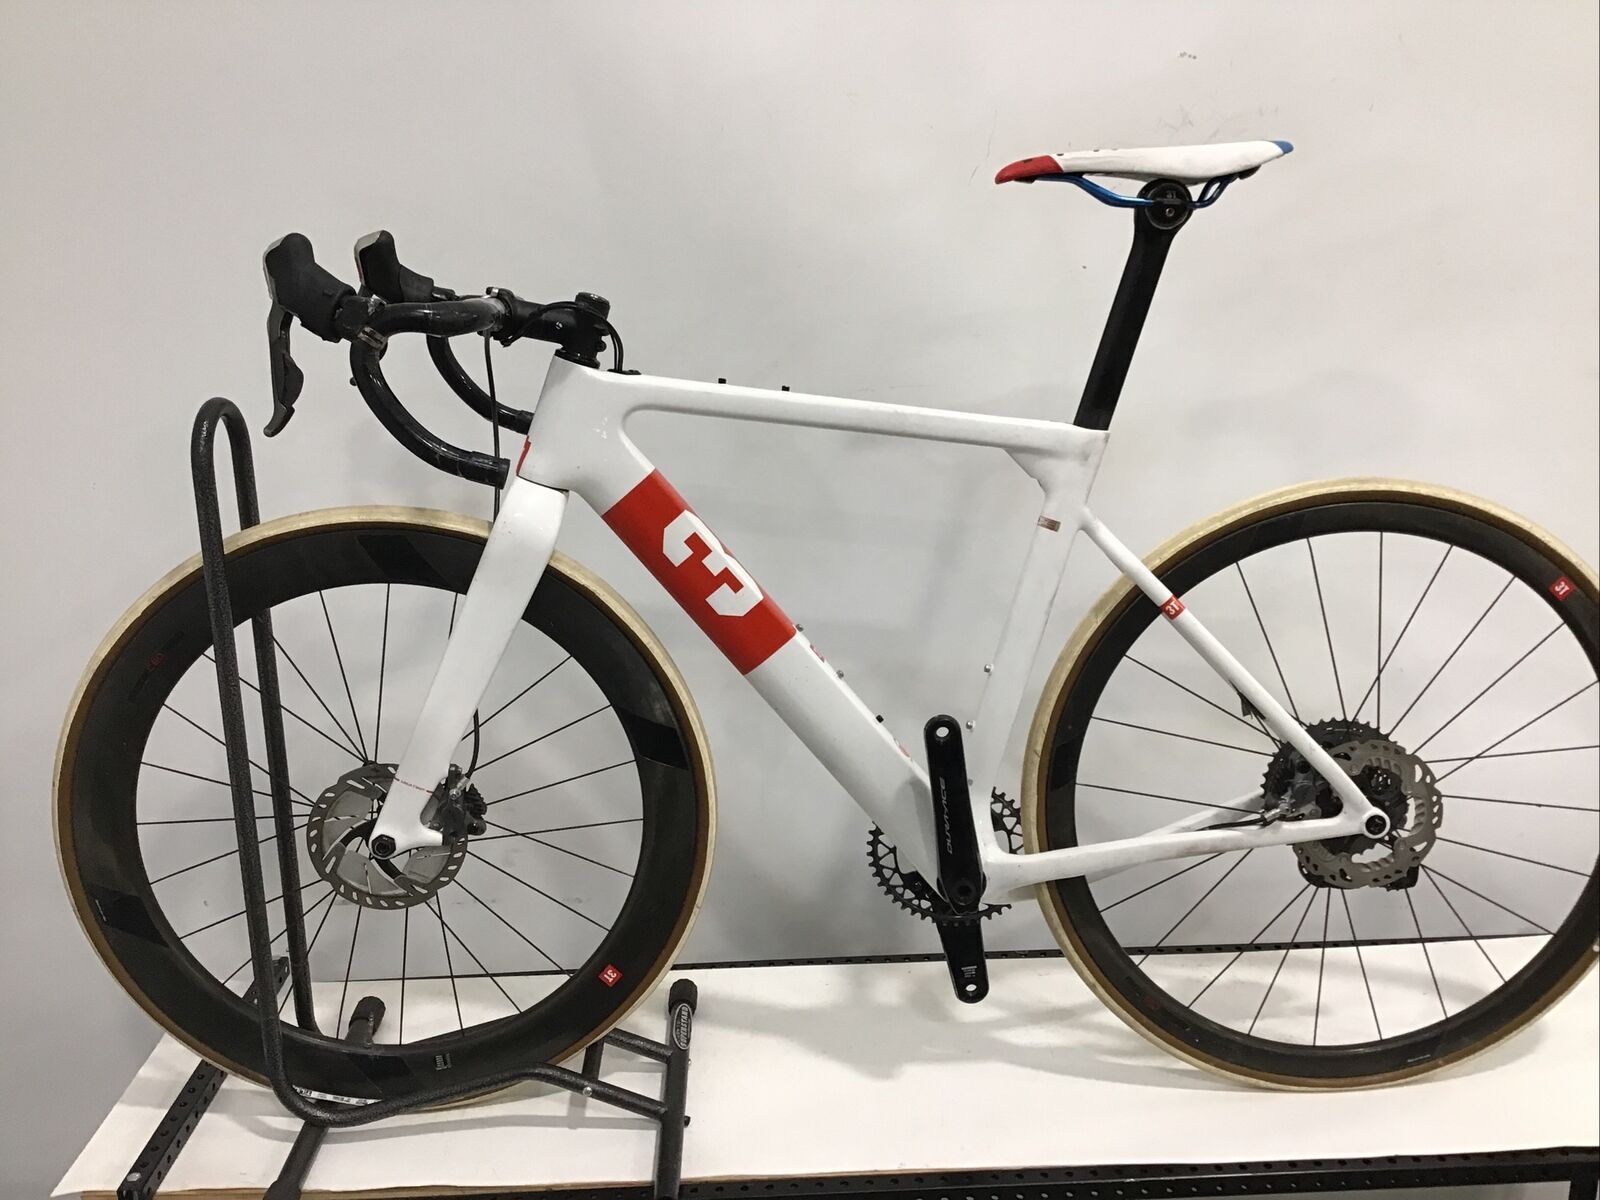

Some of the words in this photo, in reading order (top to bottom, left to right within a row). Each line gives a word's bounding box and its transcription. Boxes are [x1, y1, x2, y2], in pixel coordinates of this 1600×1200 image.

[662, 509, 764, 617] 3
[1554, 581, 1570, 595] 3T
[1165, 600, 1180, 615] 3T
[603, 969, 617, 983] 3T
[680, 1005, 689, 1047] SUPERSTAND
